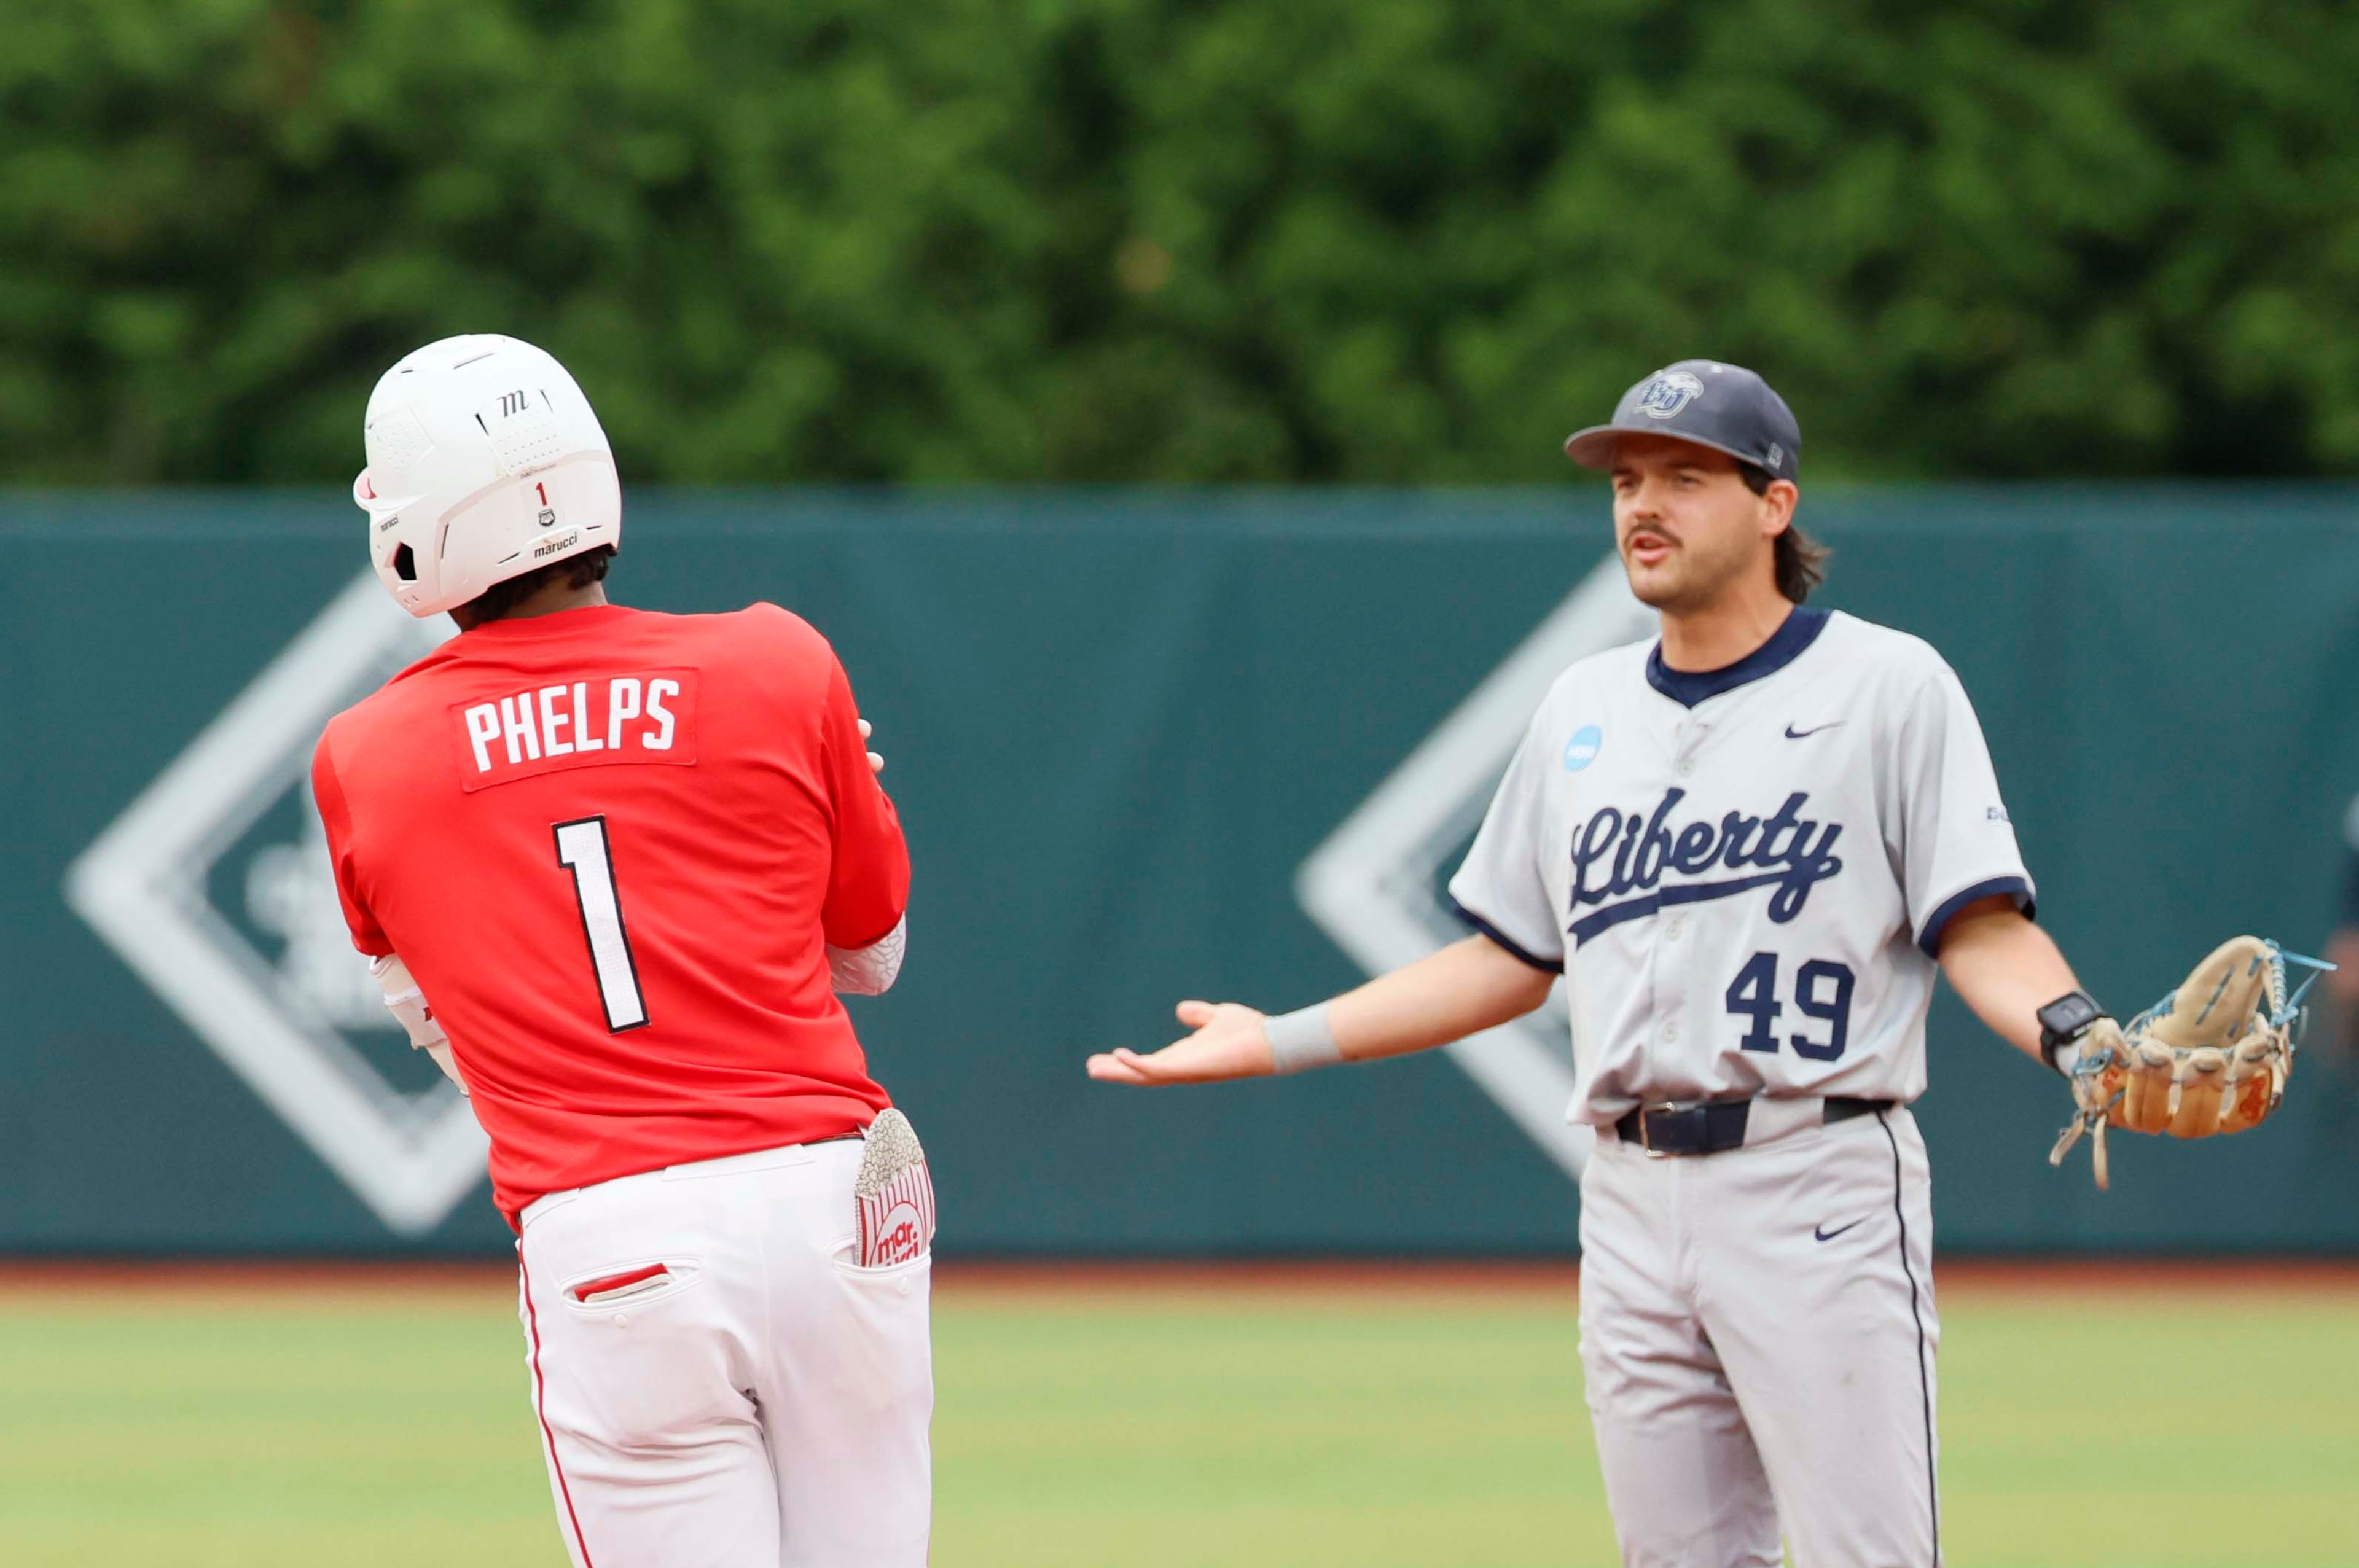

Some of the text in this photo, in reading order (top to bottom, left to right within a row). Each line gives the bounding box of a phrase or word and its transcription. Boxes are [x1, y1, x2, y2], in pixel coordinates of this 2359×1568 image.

[534, 531, 577, 558] marucci
[536, 482, 548, 507] 1
[464, 677, 679, 773] PHELPS
[1568, 787, 1842, 924] Liberty
[550, 813, 651, 1036] 1
[1726, 951, 1855, 1063] 49
